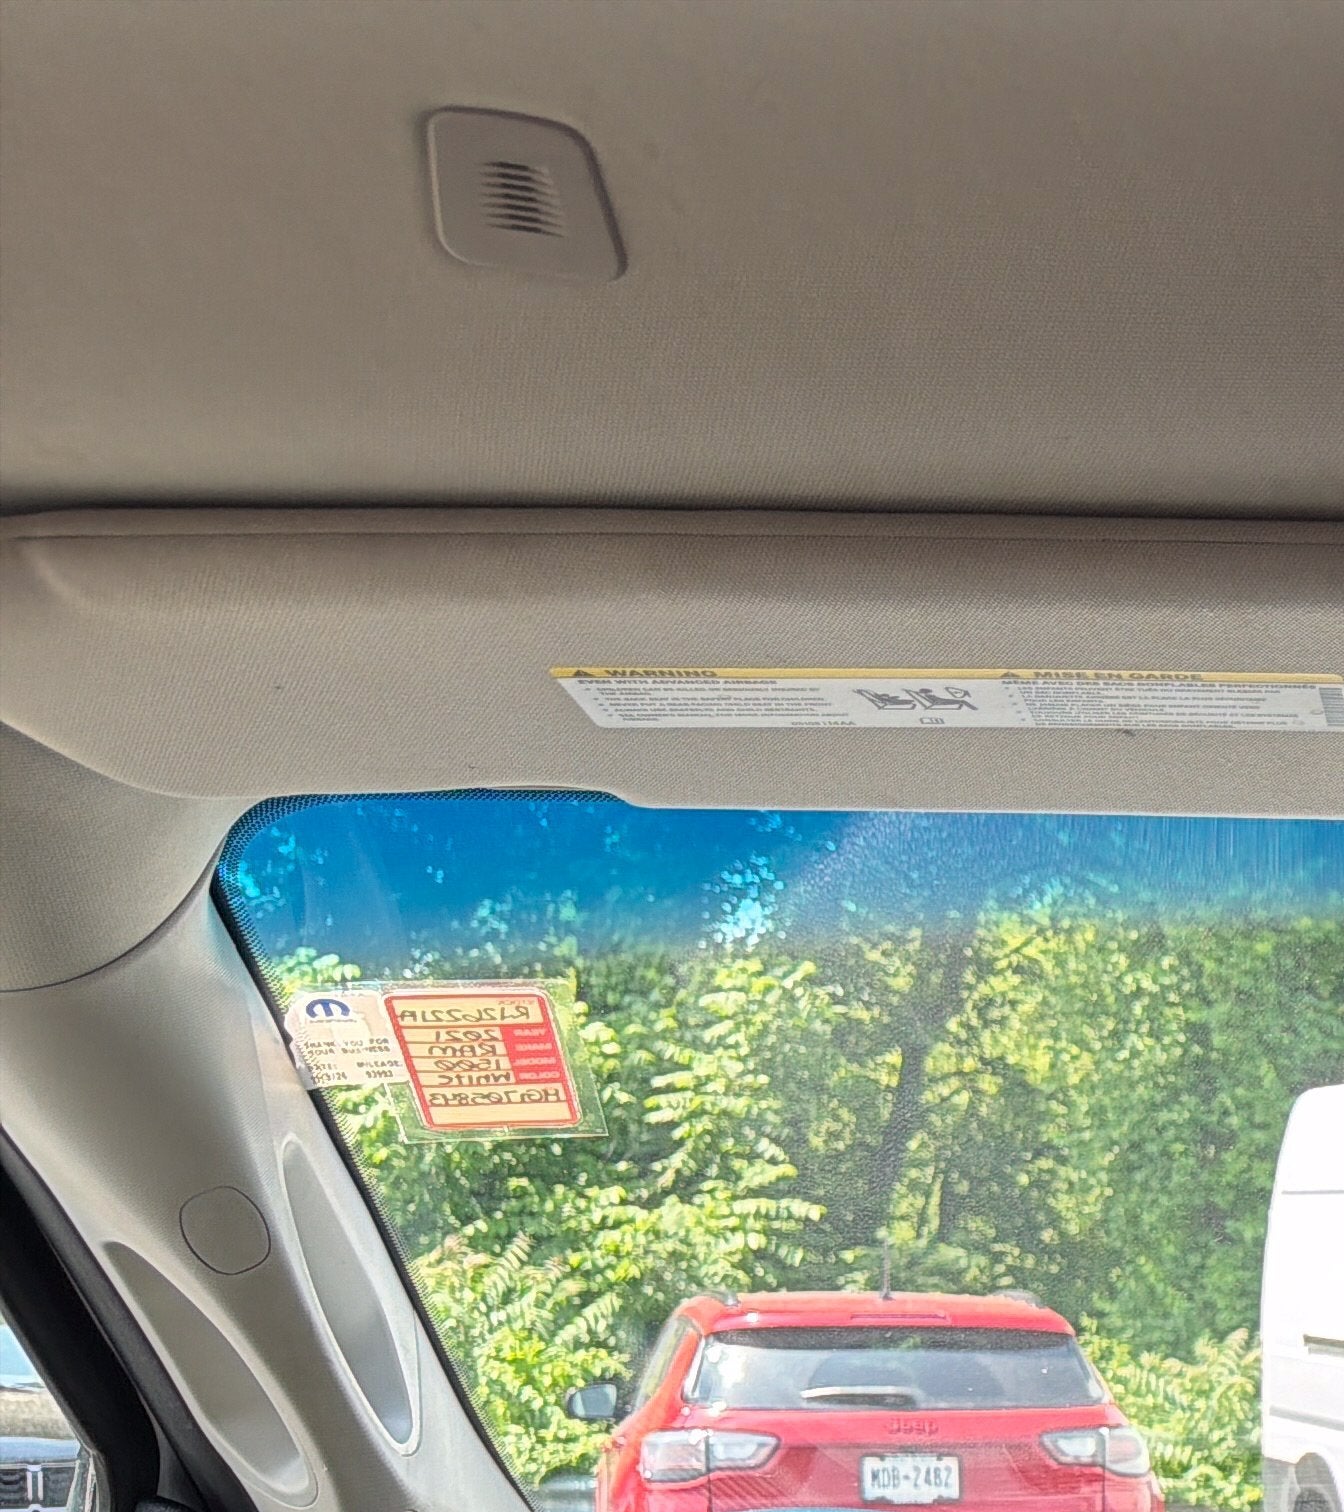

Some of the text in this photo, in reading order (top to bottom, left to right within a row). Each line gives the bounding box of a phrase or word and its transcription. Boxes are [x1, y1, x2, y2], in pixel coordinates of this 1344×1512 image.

[604, 669, 718, 678] WARNING
[1034, 671, 1087, 680] MISE
[1129, 673, 1203, 681] GARDE
[889, 1418, 939, 1436] Jeep
